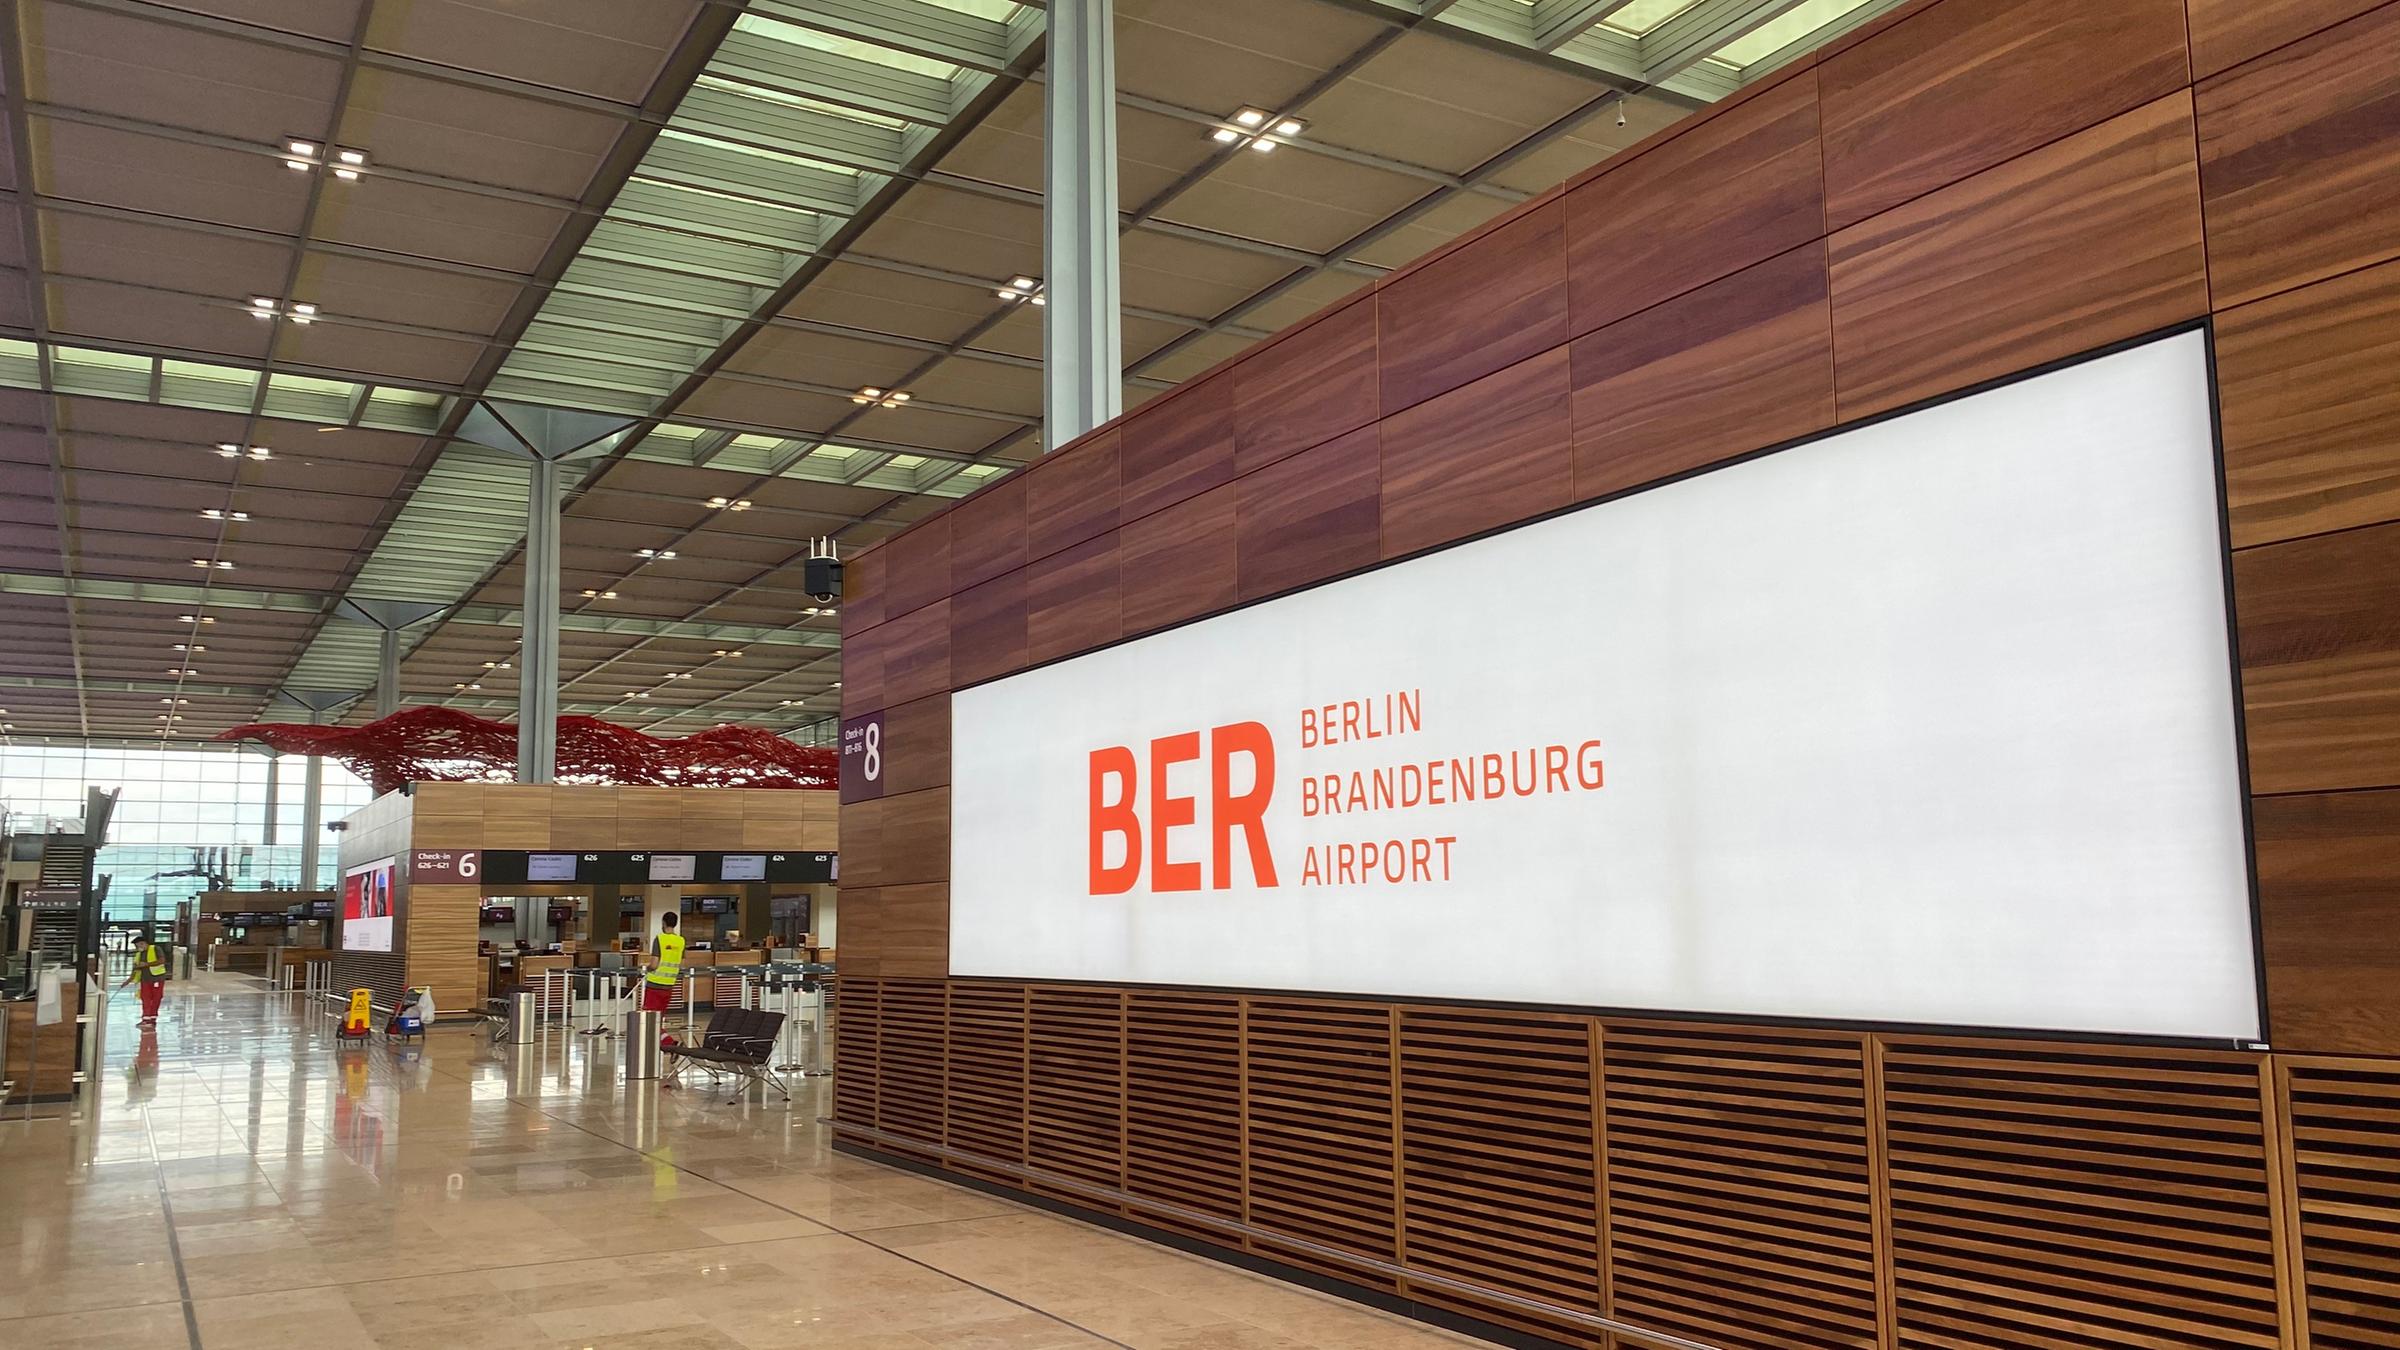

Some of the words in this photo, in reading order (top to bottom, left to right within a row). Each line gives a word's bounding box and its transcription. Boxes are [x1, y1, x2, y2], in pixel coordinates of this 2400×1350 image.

[1301, 688, 1421, 749] BERLIN
[864, 722, 880, 781] 8
[1301, 739, 1604, 817] BRANDENBURG
[1088, 720, 1280, 896] BER
[418, 852, 451, 860] Check-in
[458, 853, 476, 877] 6
[1301, 836, 1457, 885] AIRPORT
